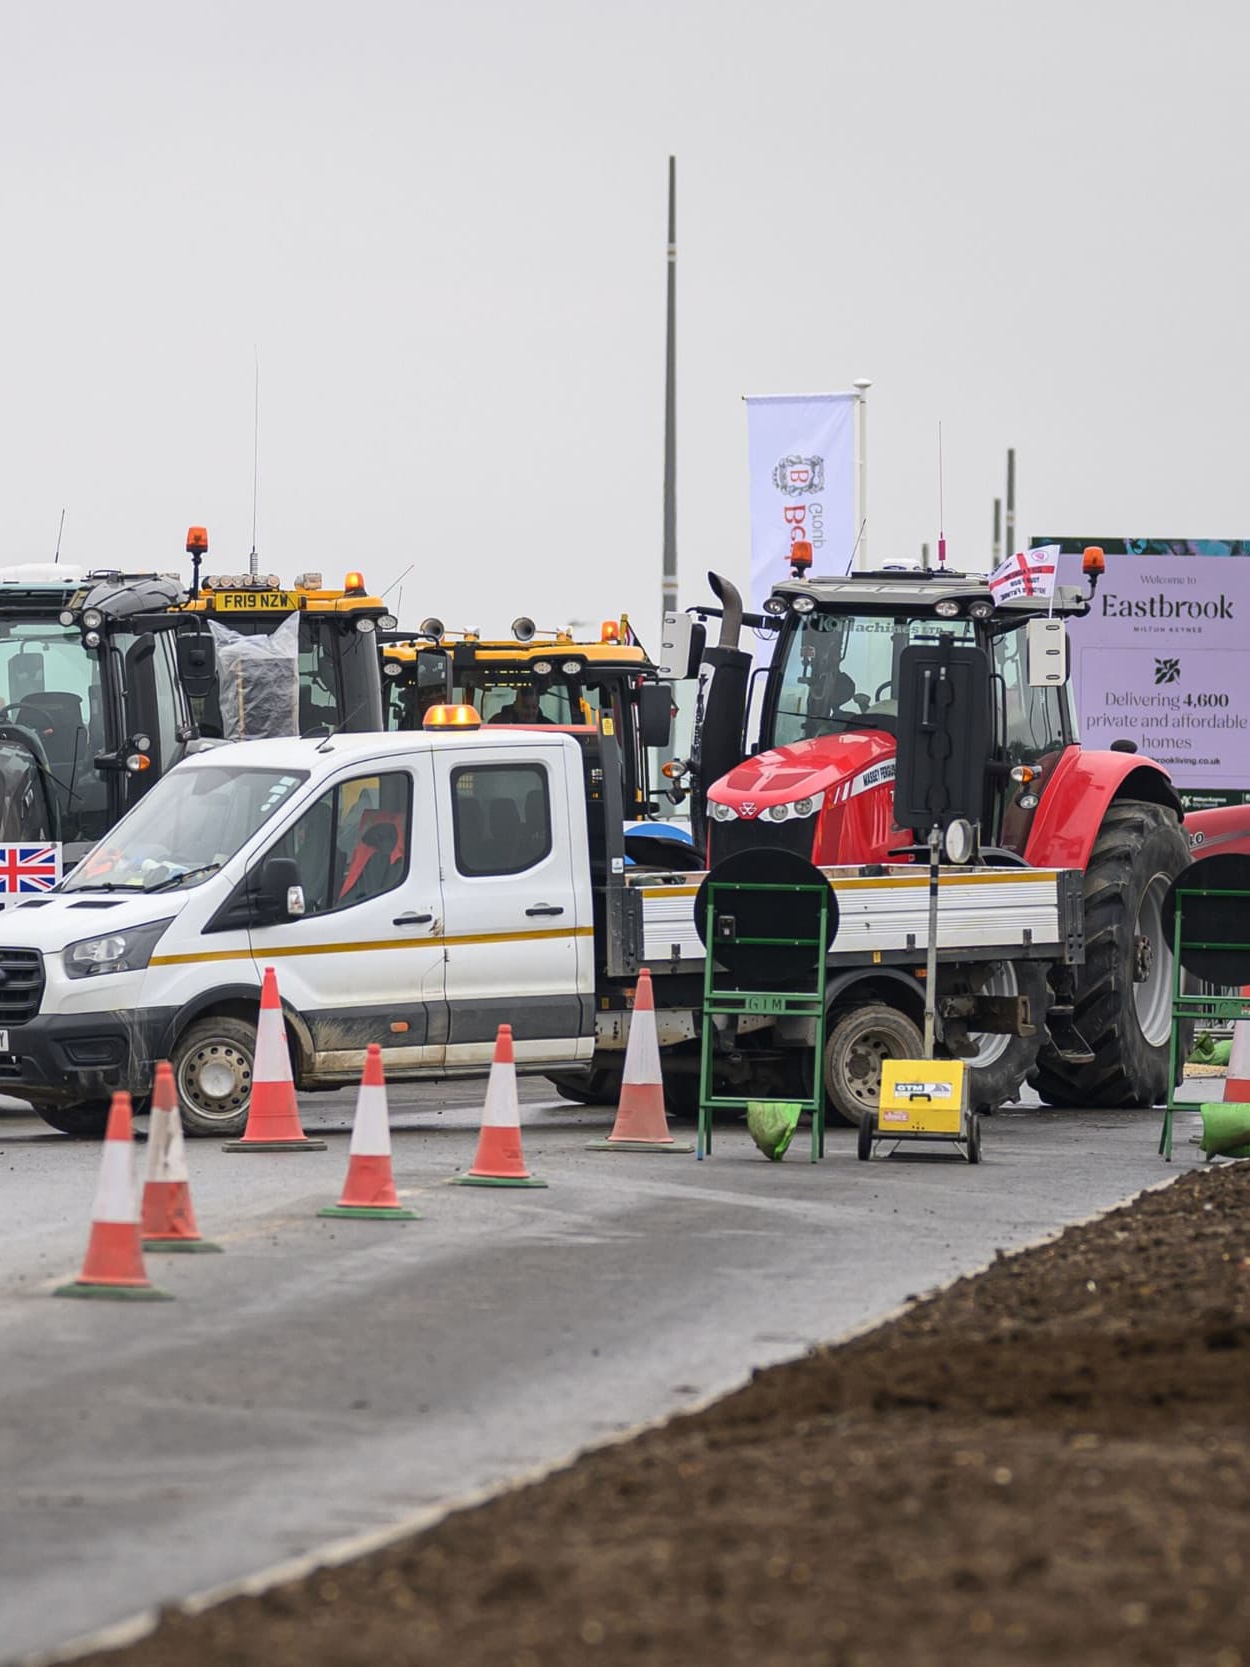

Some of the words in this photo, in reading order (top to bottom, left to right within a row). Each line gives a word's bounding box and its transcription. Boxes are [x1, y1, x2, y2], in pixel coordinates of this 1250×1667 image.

[1140, 575, 1184, 585] Welcome
[1187, 575, 1197, 585] to
[224, 595, 256, 608] FR19
[260, 594, 288, 607] NZW
[1102, 593, 1234, 619] Eastbrook
[1105, 692, 1180, 711] Delivering
[1183, 693, 1230, 709] 4,600
[1086, 713, 1138, 730] private
[1141, 713, 1169, 728] and
[1171, 714, 1248, 729] affordable
[1141, 733, 1192, 750] homes
[896, 1084, 923, 1092] GTM
